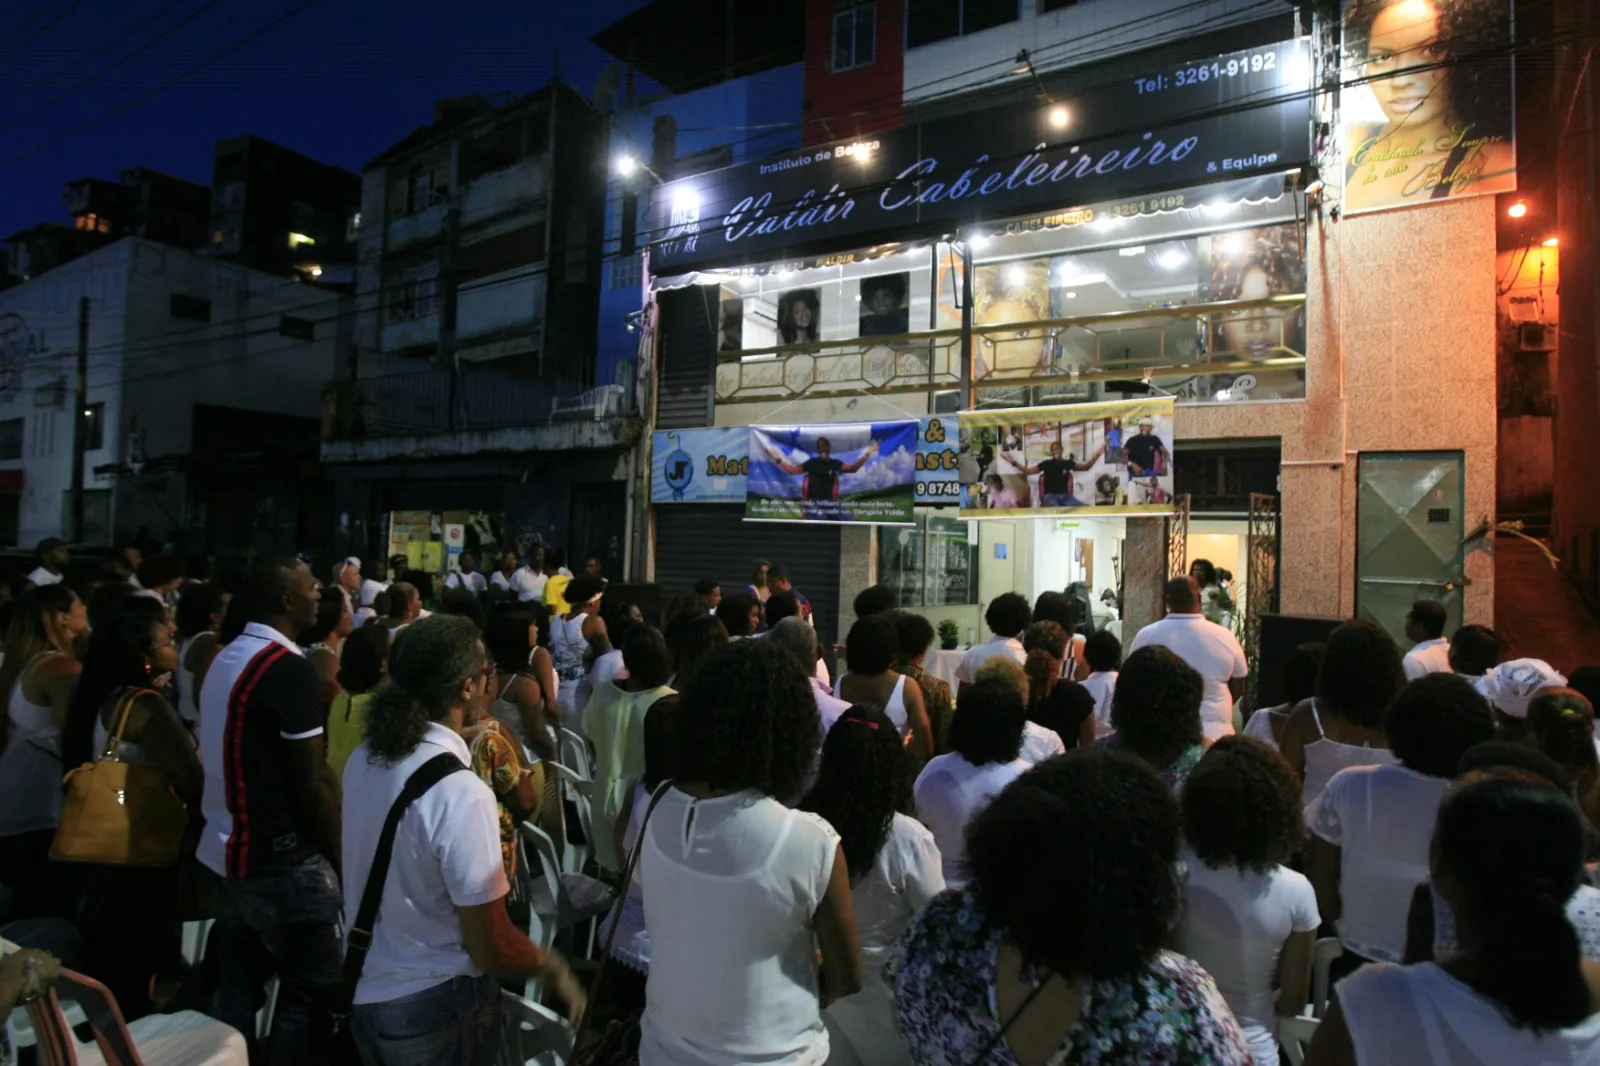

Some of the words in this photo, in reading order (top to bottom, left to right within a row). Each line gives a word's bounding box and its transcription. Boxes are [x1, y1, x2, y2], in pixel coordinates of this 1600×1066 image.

[1134, 74, 1169, 95] Tel:
[1175, 52, 1277, 87] 3261-9192
[1434, 122, 1504, 163] Sempre
[760, 155, 812, 175] Instituto
[815, 150, 832, 162] de
[879, 131, 1199, 211] Cabeleireiro
[1206, 160, 1218, 173] &
[1222, 152, 1279, 171] Equipe
[924, 418, 946, 443] &
